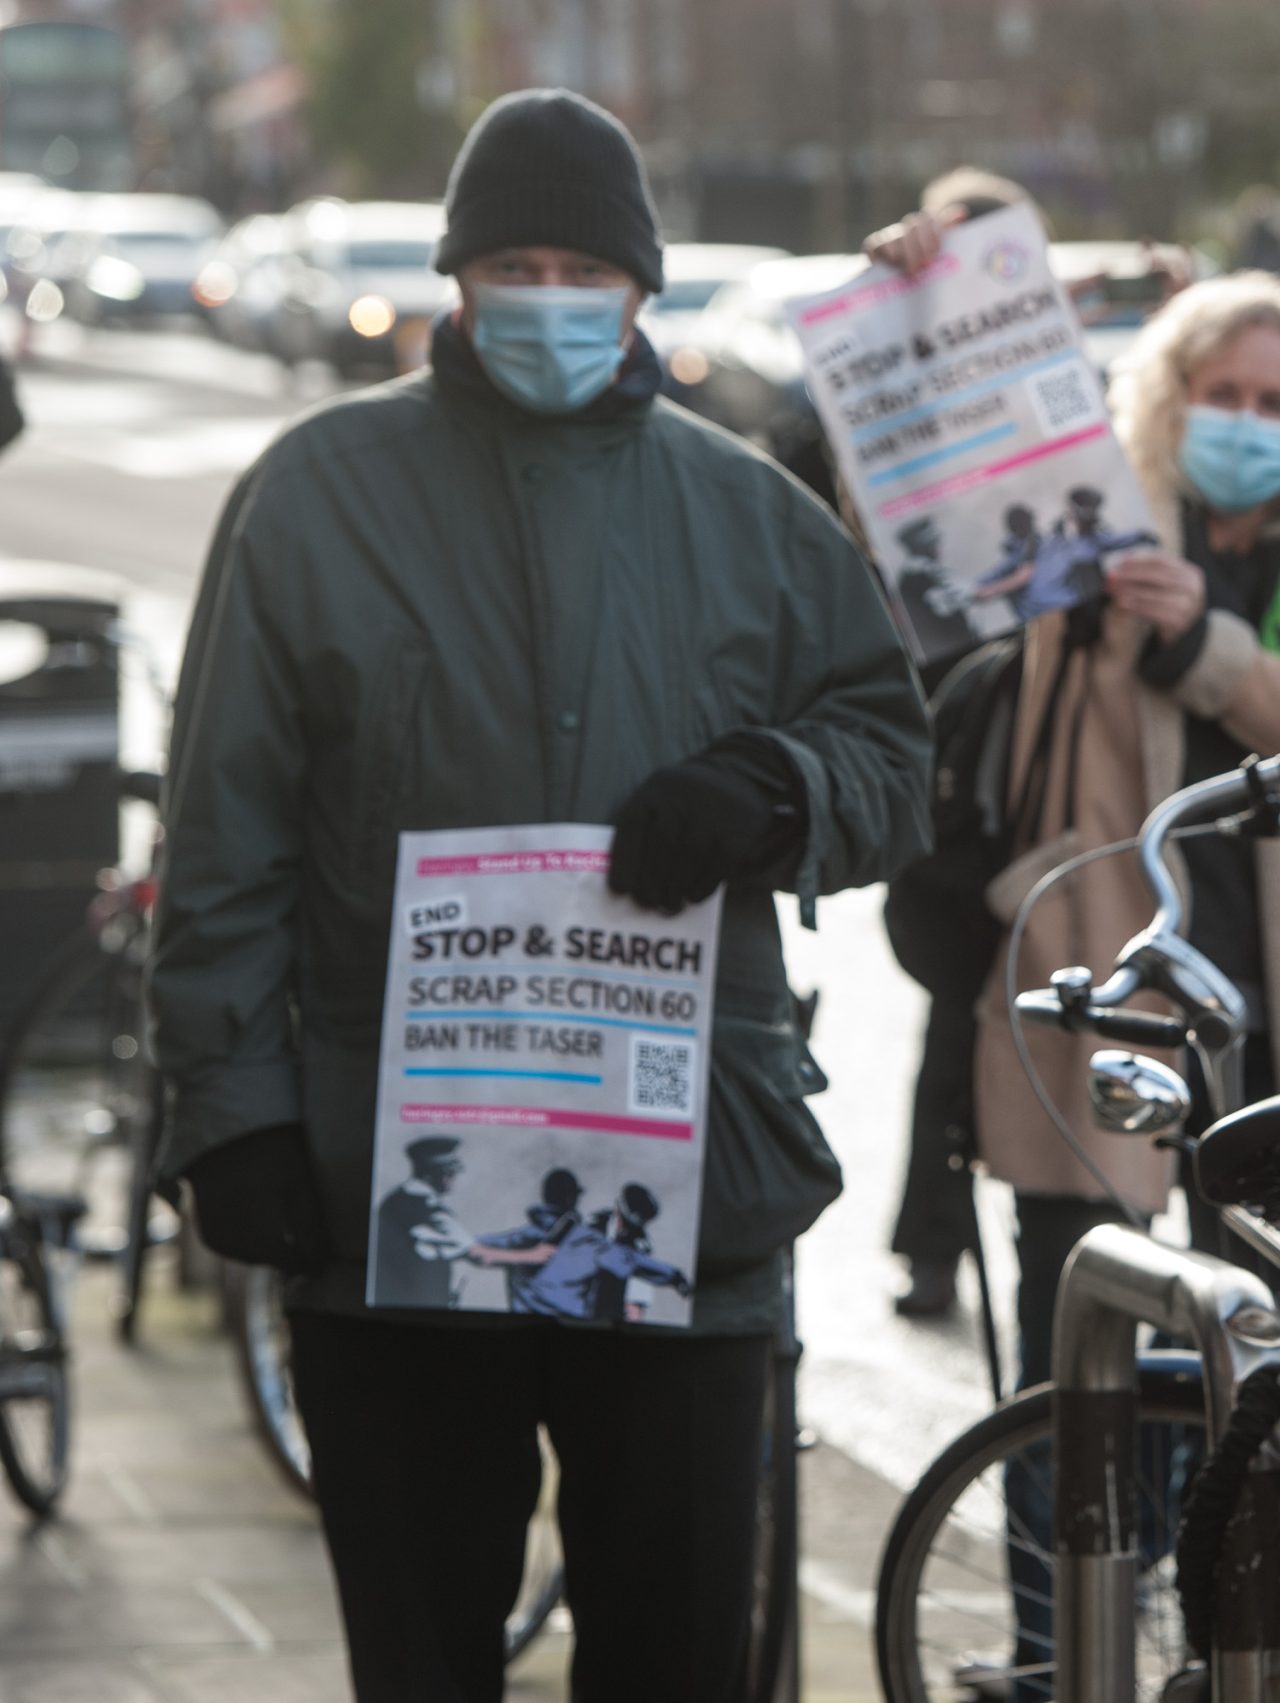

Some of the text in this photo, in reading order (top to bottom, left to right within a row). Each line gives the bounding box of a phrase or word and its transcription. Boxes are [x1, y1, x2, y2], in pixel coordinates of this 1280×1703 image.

[410, 902, 461, 926] END
[411, 925, 702, 973] STOP & SEARCH
[408, 976, 697, 1021] SCRAP SECTION 60
[404, 1024, 605, 1057] BAN THE TASER
